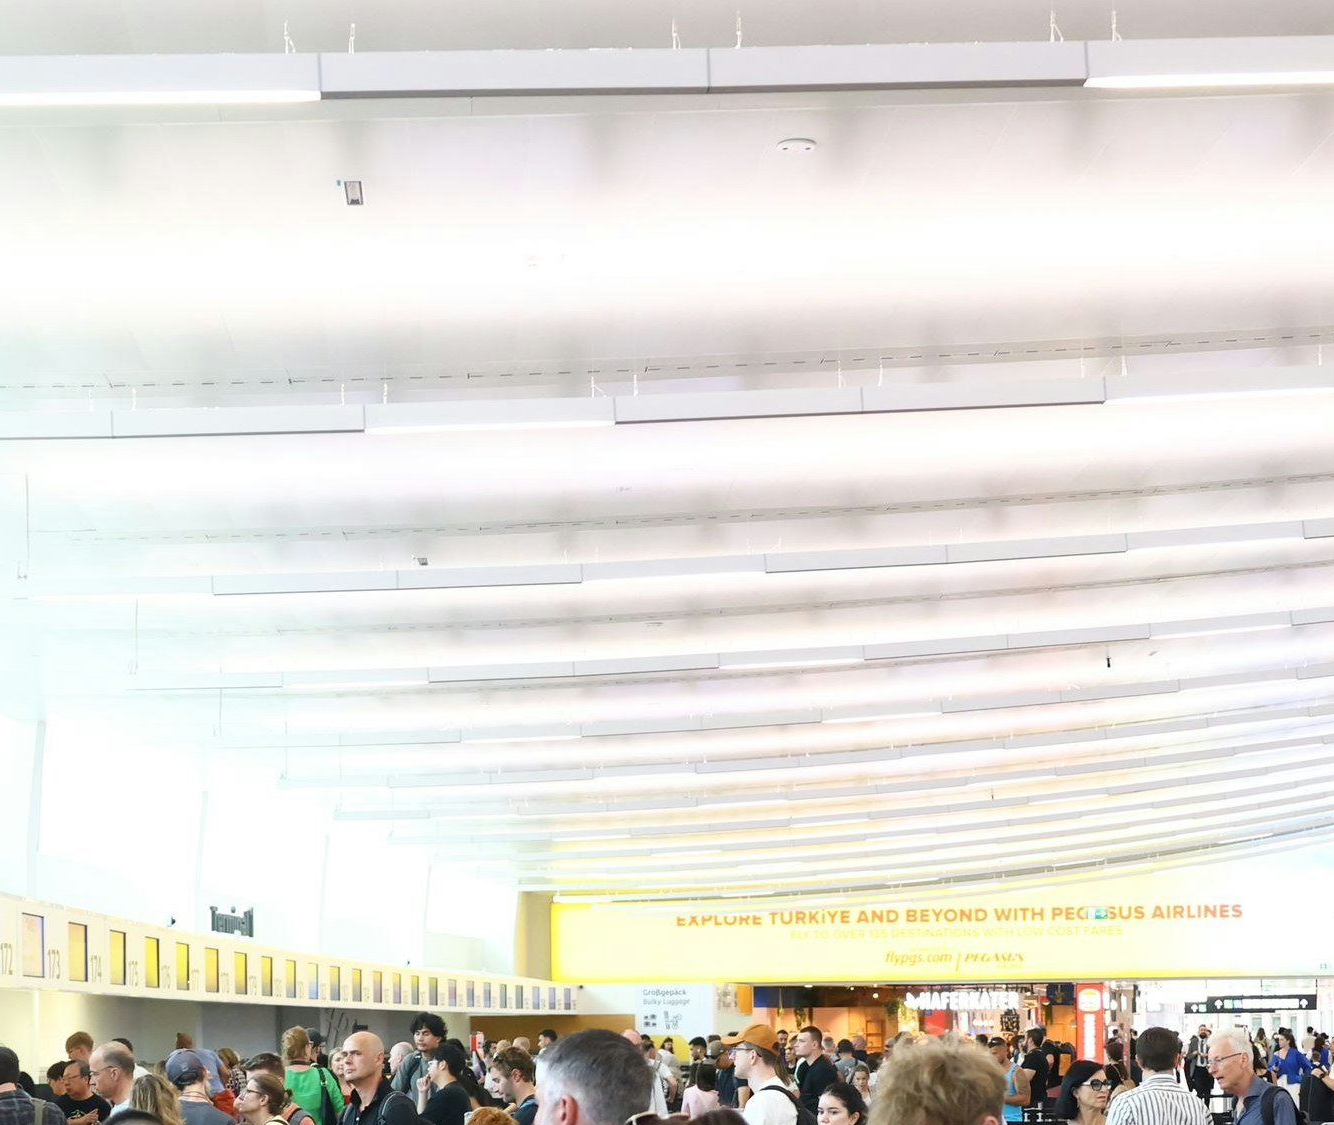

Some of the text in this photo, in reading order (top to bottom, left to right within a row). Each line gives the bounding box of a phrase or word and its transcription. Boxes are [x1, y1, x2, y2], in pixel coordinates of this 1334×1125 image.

[677, 914, 763, 927] EXPLORE
[856, 910, 900, 924] AND
[906, 908, 988, 923] BEYOND
[994, 906, 1044, 922] WITH
[1051, 905, 1146, 921] PEGSUS
[1151, 904, 1244, 920] AIRLINES
[892, 927, 980, 938] DESTINATIONS
[983, 927, 1015, 937] WITH
[1047, 926, 1080, 936] COST
[1084, 925, 1123, 936] FARES
[0, 942, 13, 976] 172
[48, 949, 61, 980] 173
[91, 954, 103, 984] 174
[885, 951, 953, 966] flypgs.com
